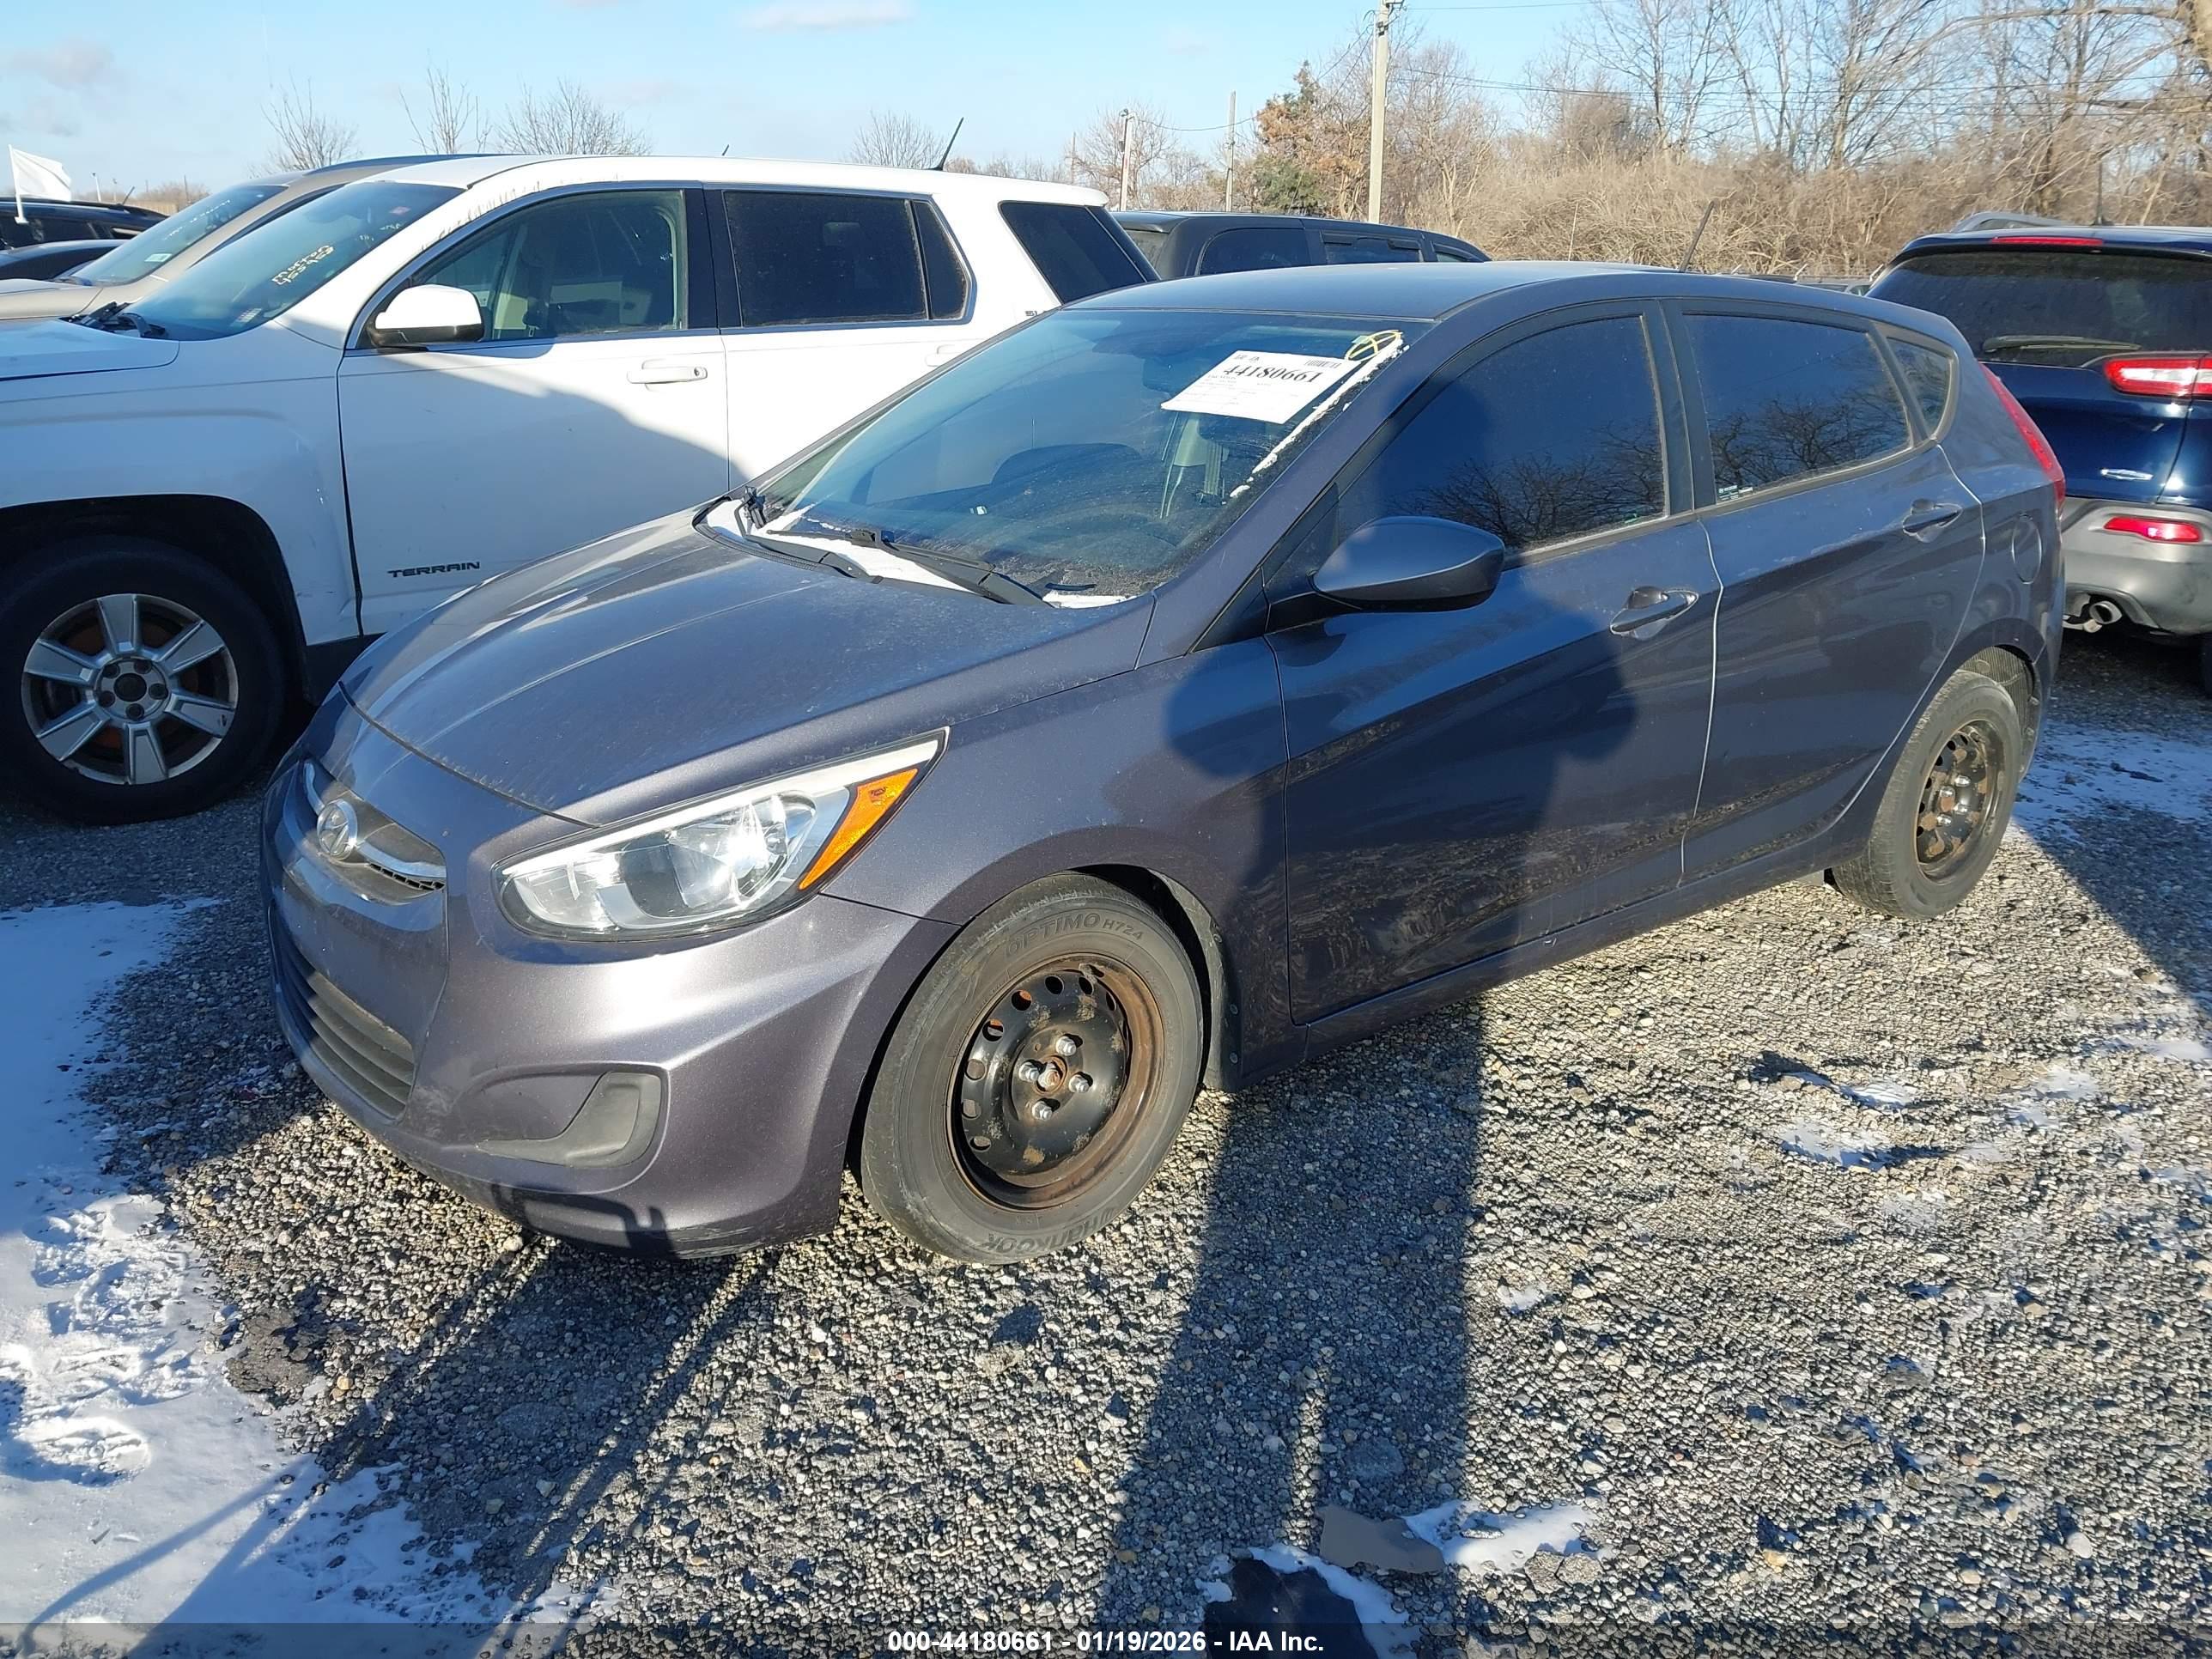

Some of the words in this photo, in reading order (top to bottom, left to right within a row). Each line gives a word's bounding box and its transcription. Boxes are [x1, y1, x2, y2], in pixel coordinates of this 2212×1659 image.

[1223, 364, 1323, 383] 44180661
[387, 562, 480, 577] TERRAIN
[1004, 912, 1101, 958] OPTIMO
[1102, 918, 1144, 940] H724
